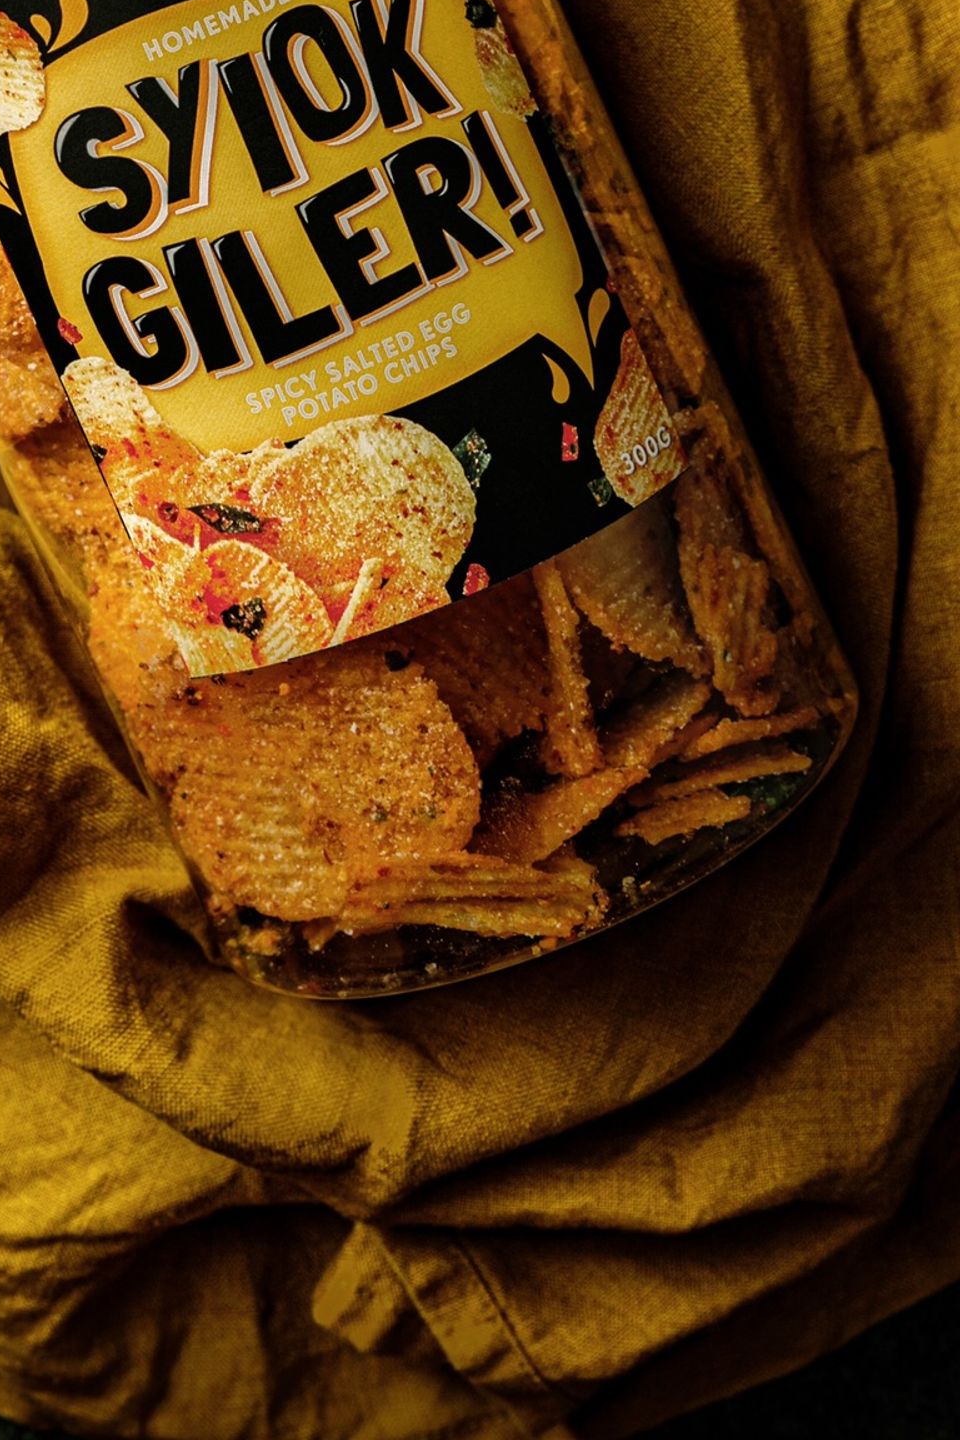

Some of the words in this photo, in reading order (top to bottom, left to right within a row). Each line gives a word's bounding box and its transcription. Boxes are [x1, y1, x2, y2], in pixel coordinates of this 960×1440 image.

[82, 110, 544, 390] GILER!
[246, 369, 318, 414] SPICY
[325, 331, 415, 383] SALTED
[418, 302, 471, 342] EGG
[281, 373, 378, 427] POTATO
[384, 336, 457, 384] CHIPS
[621, 426, 671, 475] 300G
